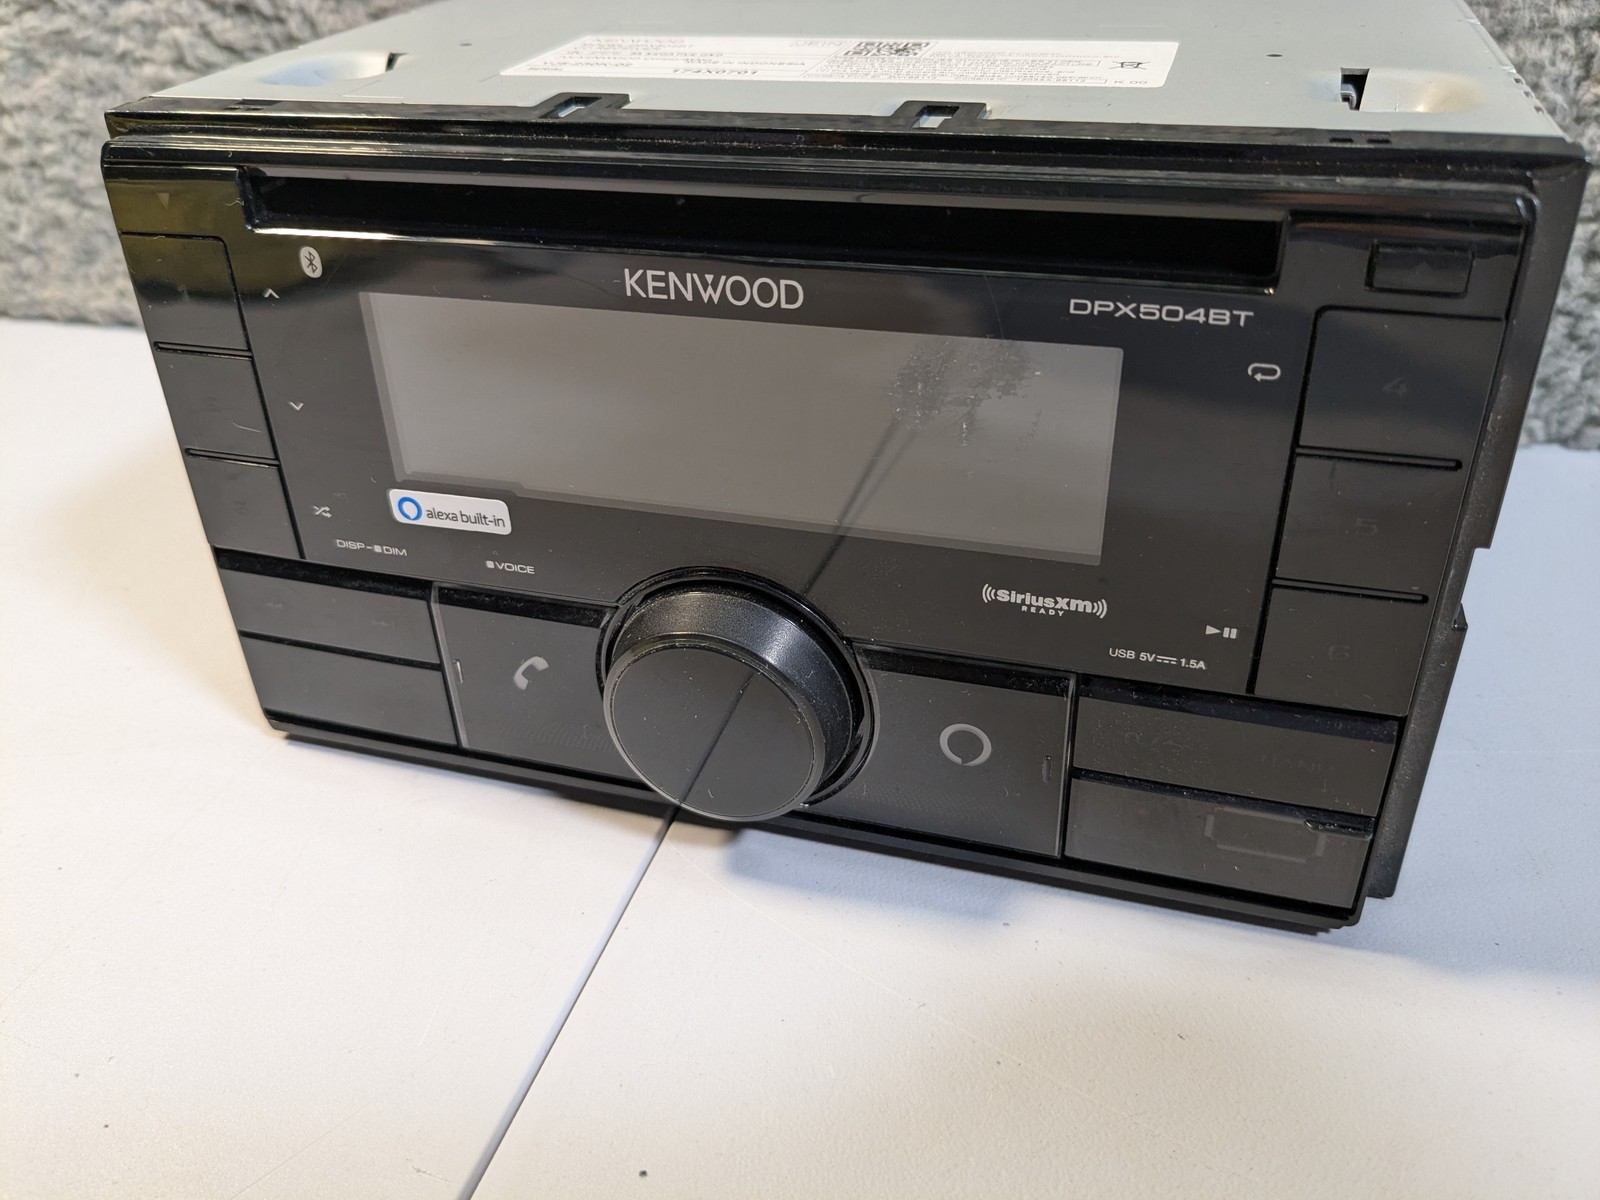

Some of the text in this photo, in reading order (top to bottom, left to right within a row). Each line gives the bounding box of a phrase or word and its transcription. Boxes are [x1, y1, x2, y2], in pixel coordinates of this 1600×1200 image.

[624, 268, 804, 309] KENWOOD
[1069, 299, 1254, 327] DPX504BT
[426, 508, 506, 528] alexa built-in
[493, 561, 536, 575] VOICE
[1021, 605, 1065, 617] READY
[1109, 647, 1206, 671] USB 5V 1.5A
